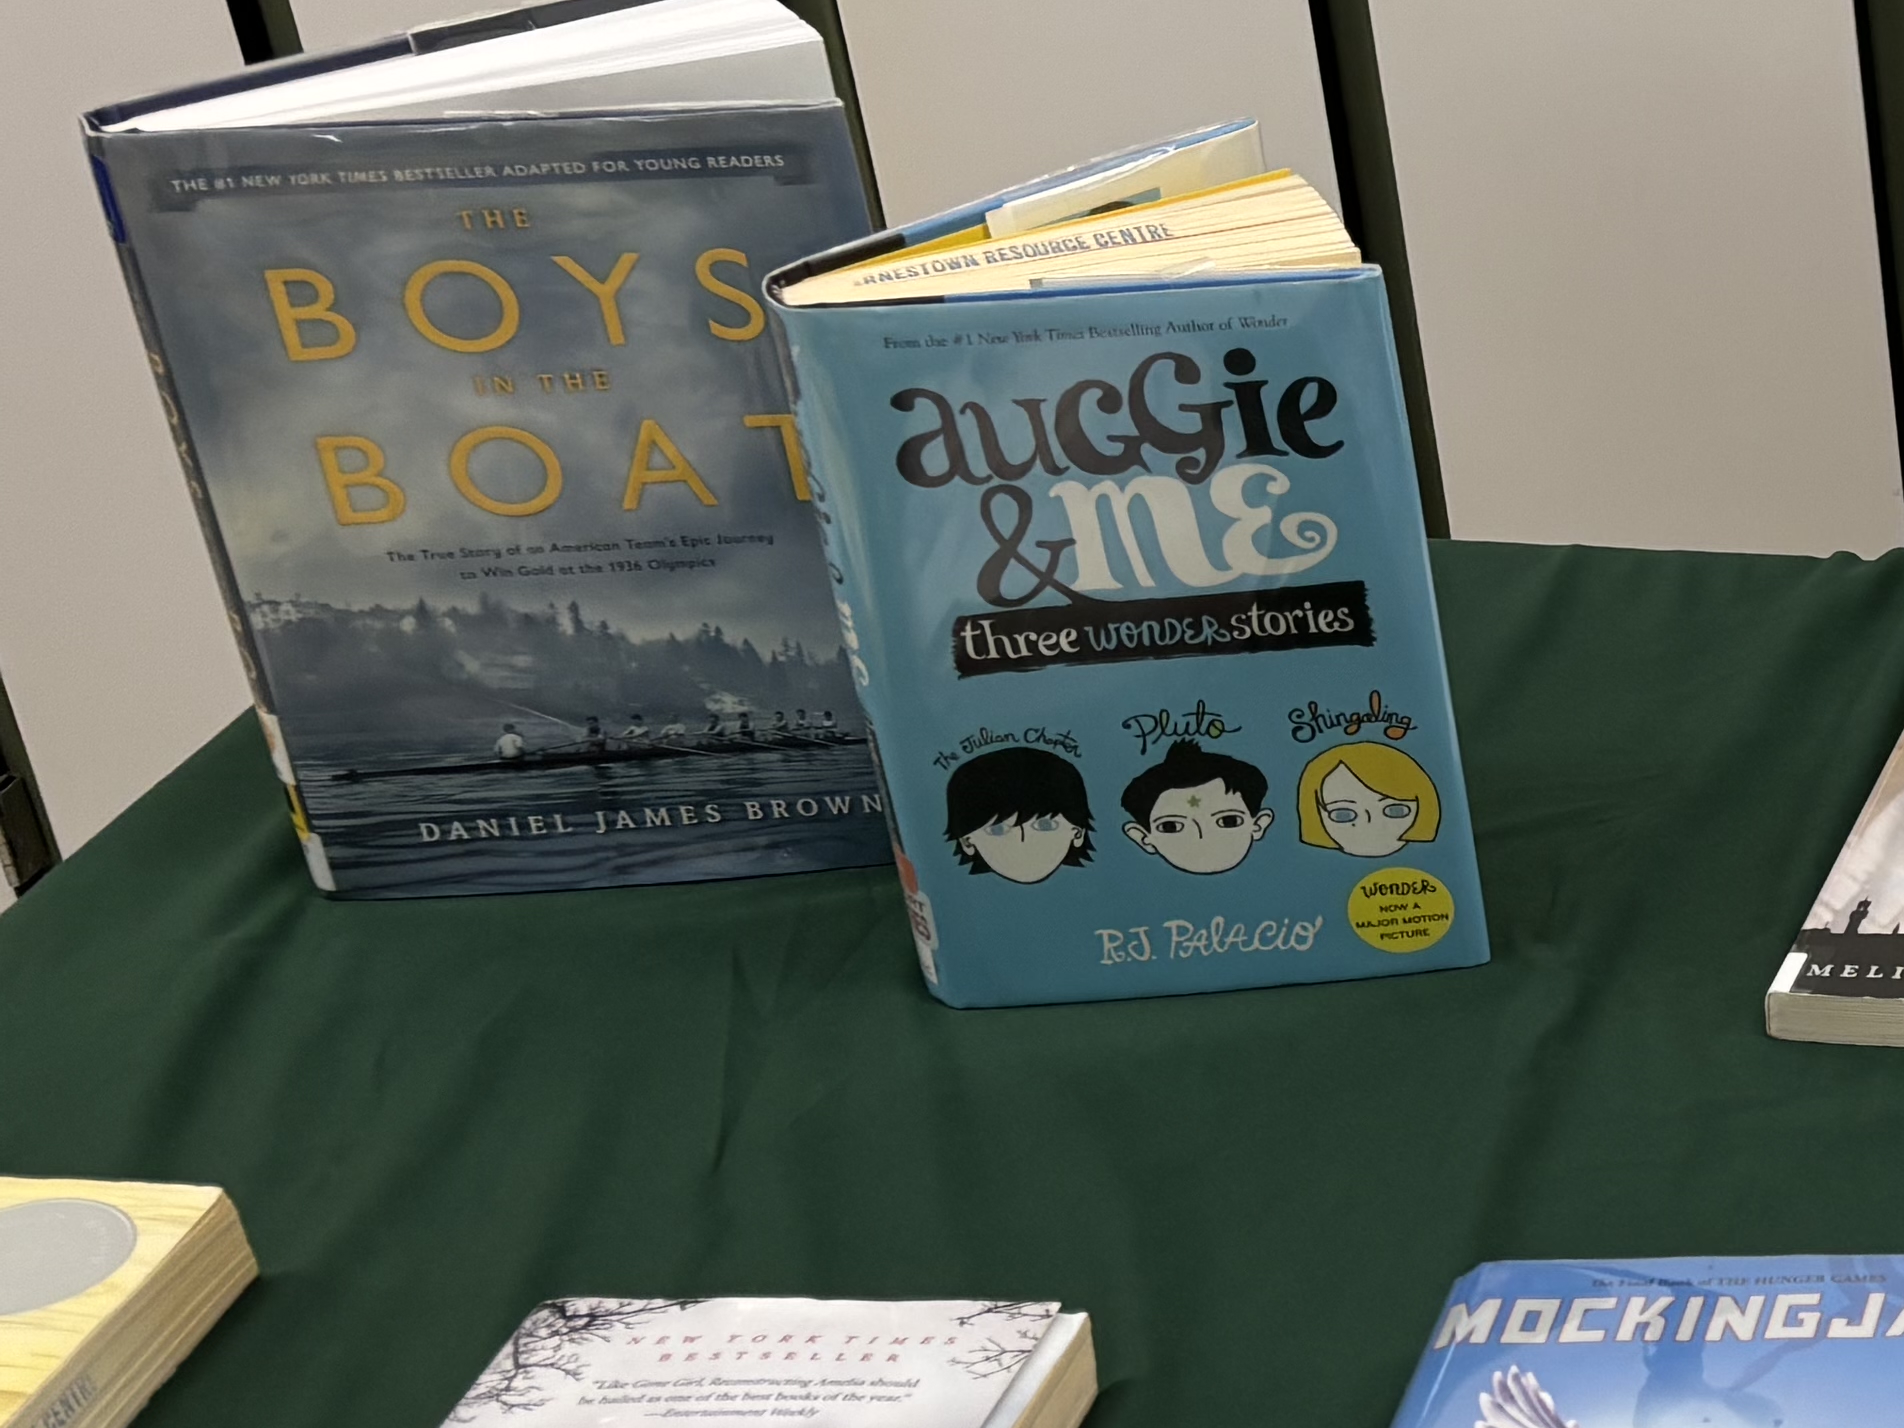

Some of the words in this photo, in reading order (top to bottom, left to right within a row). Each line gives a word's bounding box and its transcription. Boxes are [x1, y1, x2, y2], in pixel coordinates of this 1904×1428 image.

[171, 179, 209, 193] THE
[241, 175, 280, 189] NEW
[289, 173, 332, 187] YORK
[339, 170, 387, 185] TIMES
[394, 165, 496, 183] BESTSELLER
[502, 159, 586, 177] ADAPTED
[592, 158, 630, 173] FOR
[633, 155, 701, 172] YOUNG
[707, 154, 785, 169] READERS
[458, 208, 531, 231] THE
[985, 233, 1091, 265] RESOURCE
[262, 247, 767, 363] BOYS
[884, 335, 922, 350] From
[925, 334, 947, 349] the
[1046, 327, 1084, 342] Times
[1088, 323, 1162, 341] Bestselling
[1166, 319, 1214, 335] Author
[1238, 314, 1288, 330] Wonder
[473, 374, 516, 397] IN
[536, 368, 613, 395] THE
[314, 413, 813, 527] BOAT
[386, 550, 415, 562] The
[421, 548, 455, 561] True
[459, 547, 502, 560] Story
[549, 542, 620, 553] American
[680, 535, 711, 549] Epic
[976, 484, 1094, 607] &
[608, 560, 643, 572] 1936
[959, 618, 1081, 661] three
[1231, 601, 1355, 640] stories
[1122, 699, 1242, 754] Pluto
[1288, 689, 1418, 743] Shingaling
[933, 745, 960, 771] The
[959, 729, 1022, 755] Julian
[1023, 725, 1083, 759] Chapter
[419, 813, 574, 843] DANIEL
[595, 803, 723, 835] JAMES
[743, 793, 884, 821] BROWN
[1356, 917, 1399, 928] MAJOR
[1402, 913, 1449, 924] MOTION
[1379, 903, 1408, 913] NOW
[1095, 926, 1156, 965] R.J.
[1380, 928, 1431, 940] PICTURE
[626, 1335, 703, 1346] NEW
[726, 1334, 823, 1345] YORK
[844, 1335, 959, 1346] TIMES
[658, 1351, 901, 1362] BESTSELLER
